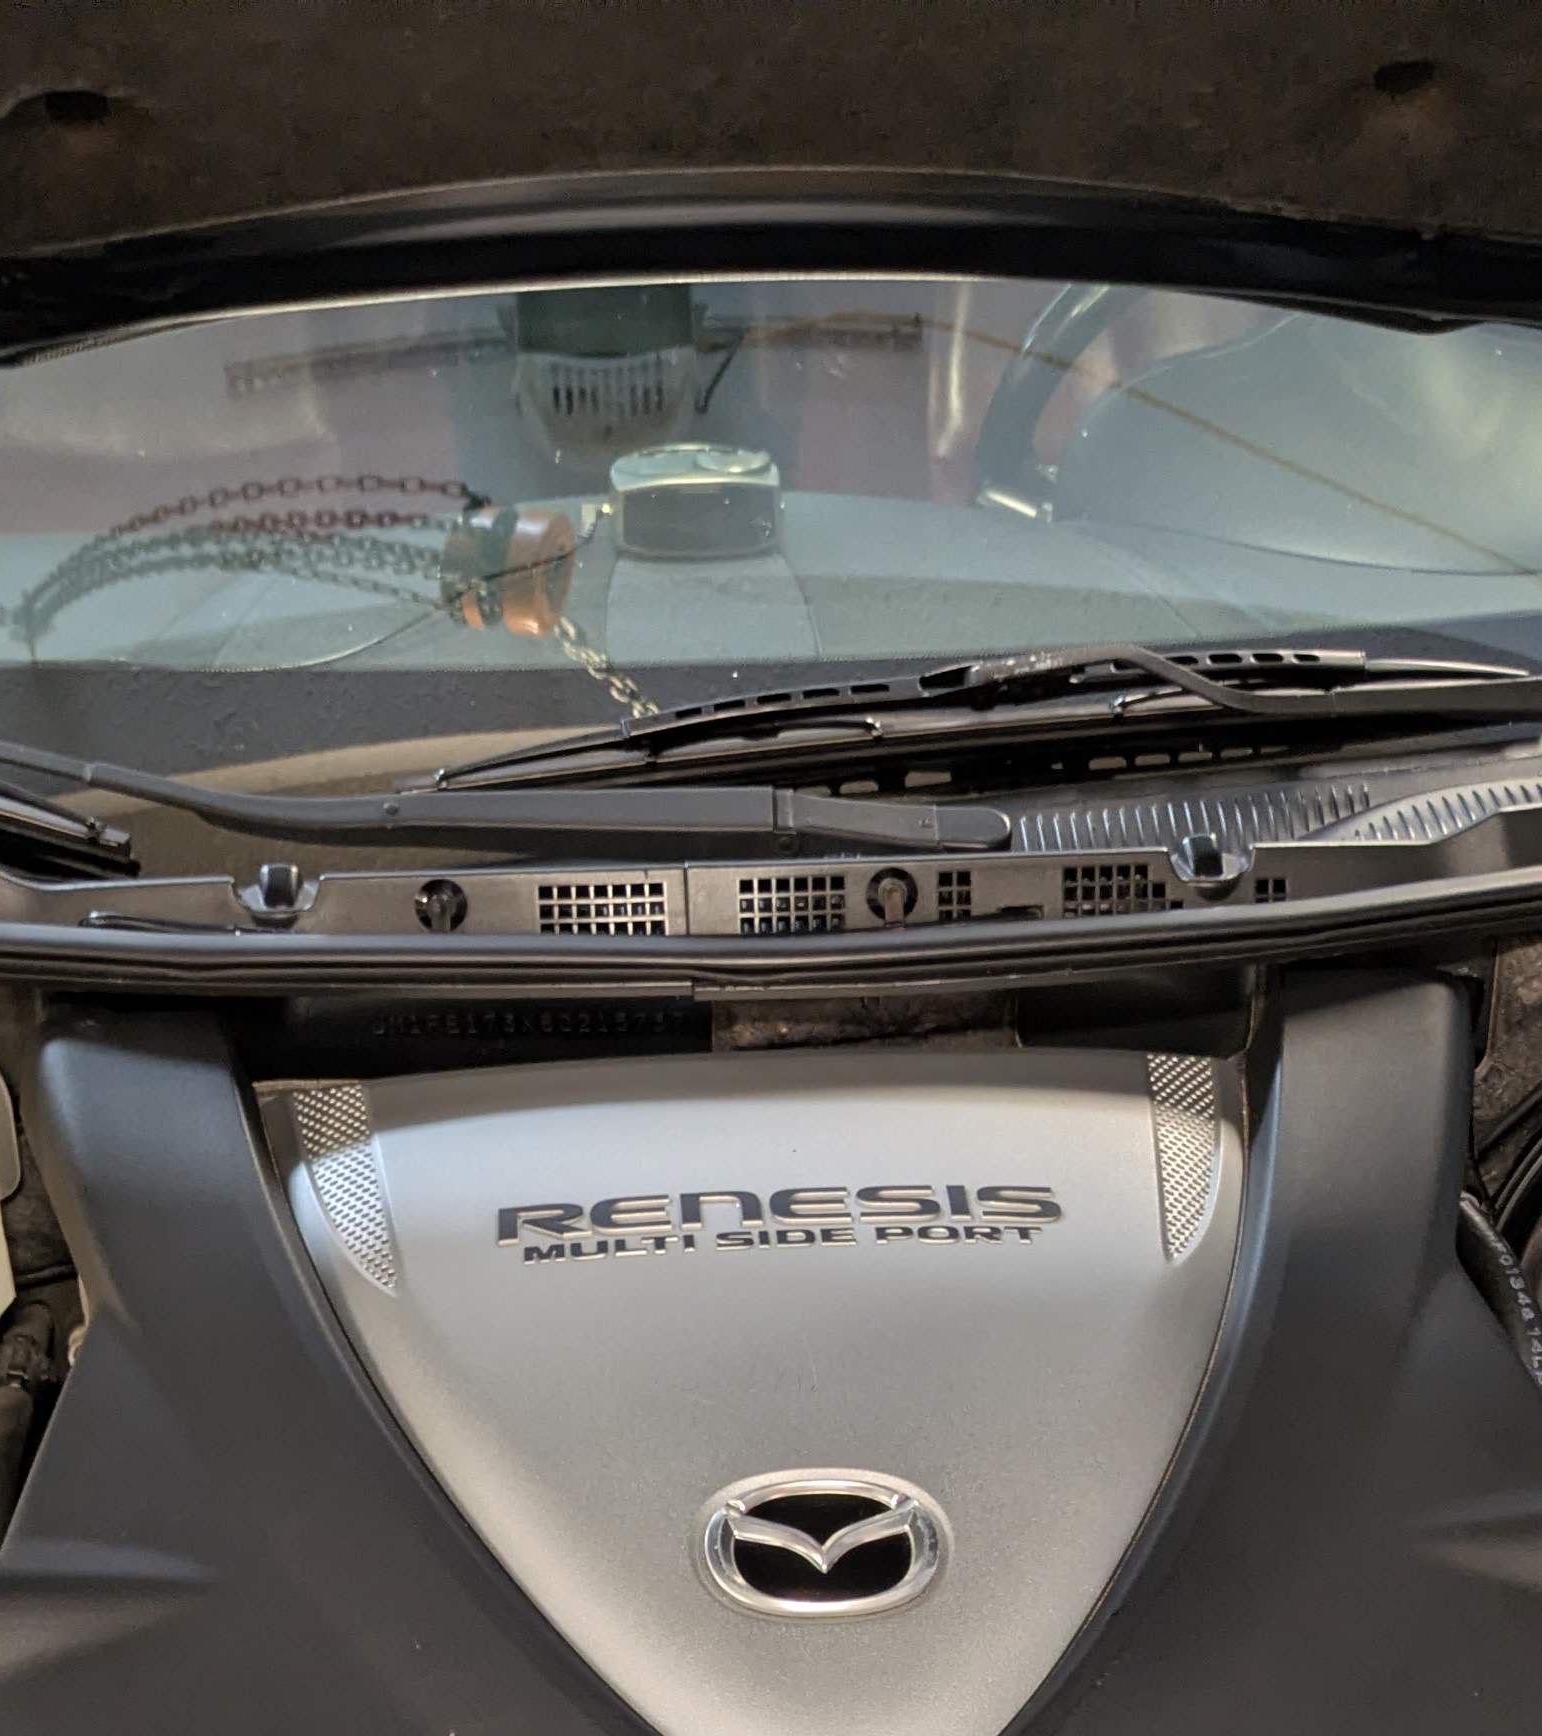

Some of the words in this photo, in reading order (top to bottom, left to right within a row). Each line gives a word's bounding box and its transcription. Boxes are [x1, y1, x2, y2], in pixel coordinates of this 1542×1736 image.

[497, 1185, 1063, 1246] RENESIS
[523, 1234, 696, 1265] MULTI
[715, 1227, 857, 1251] SIDE
[875, 1225, 1043, 1245] PORT
